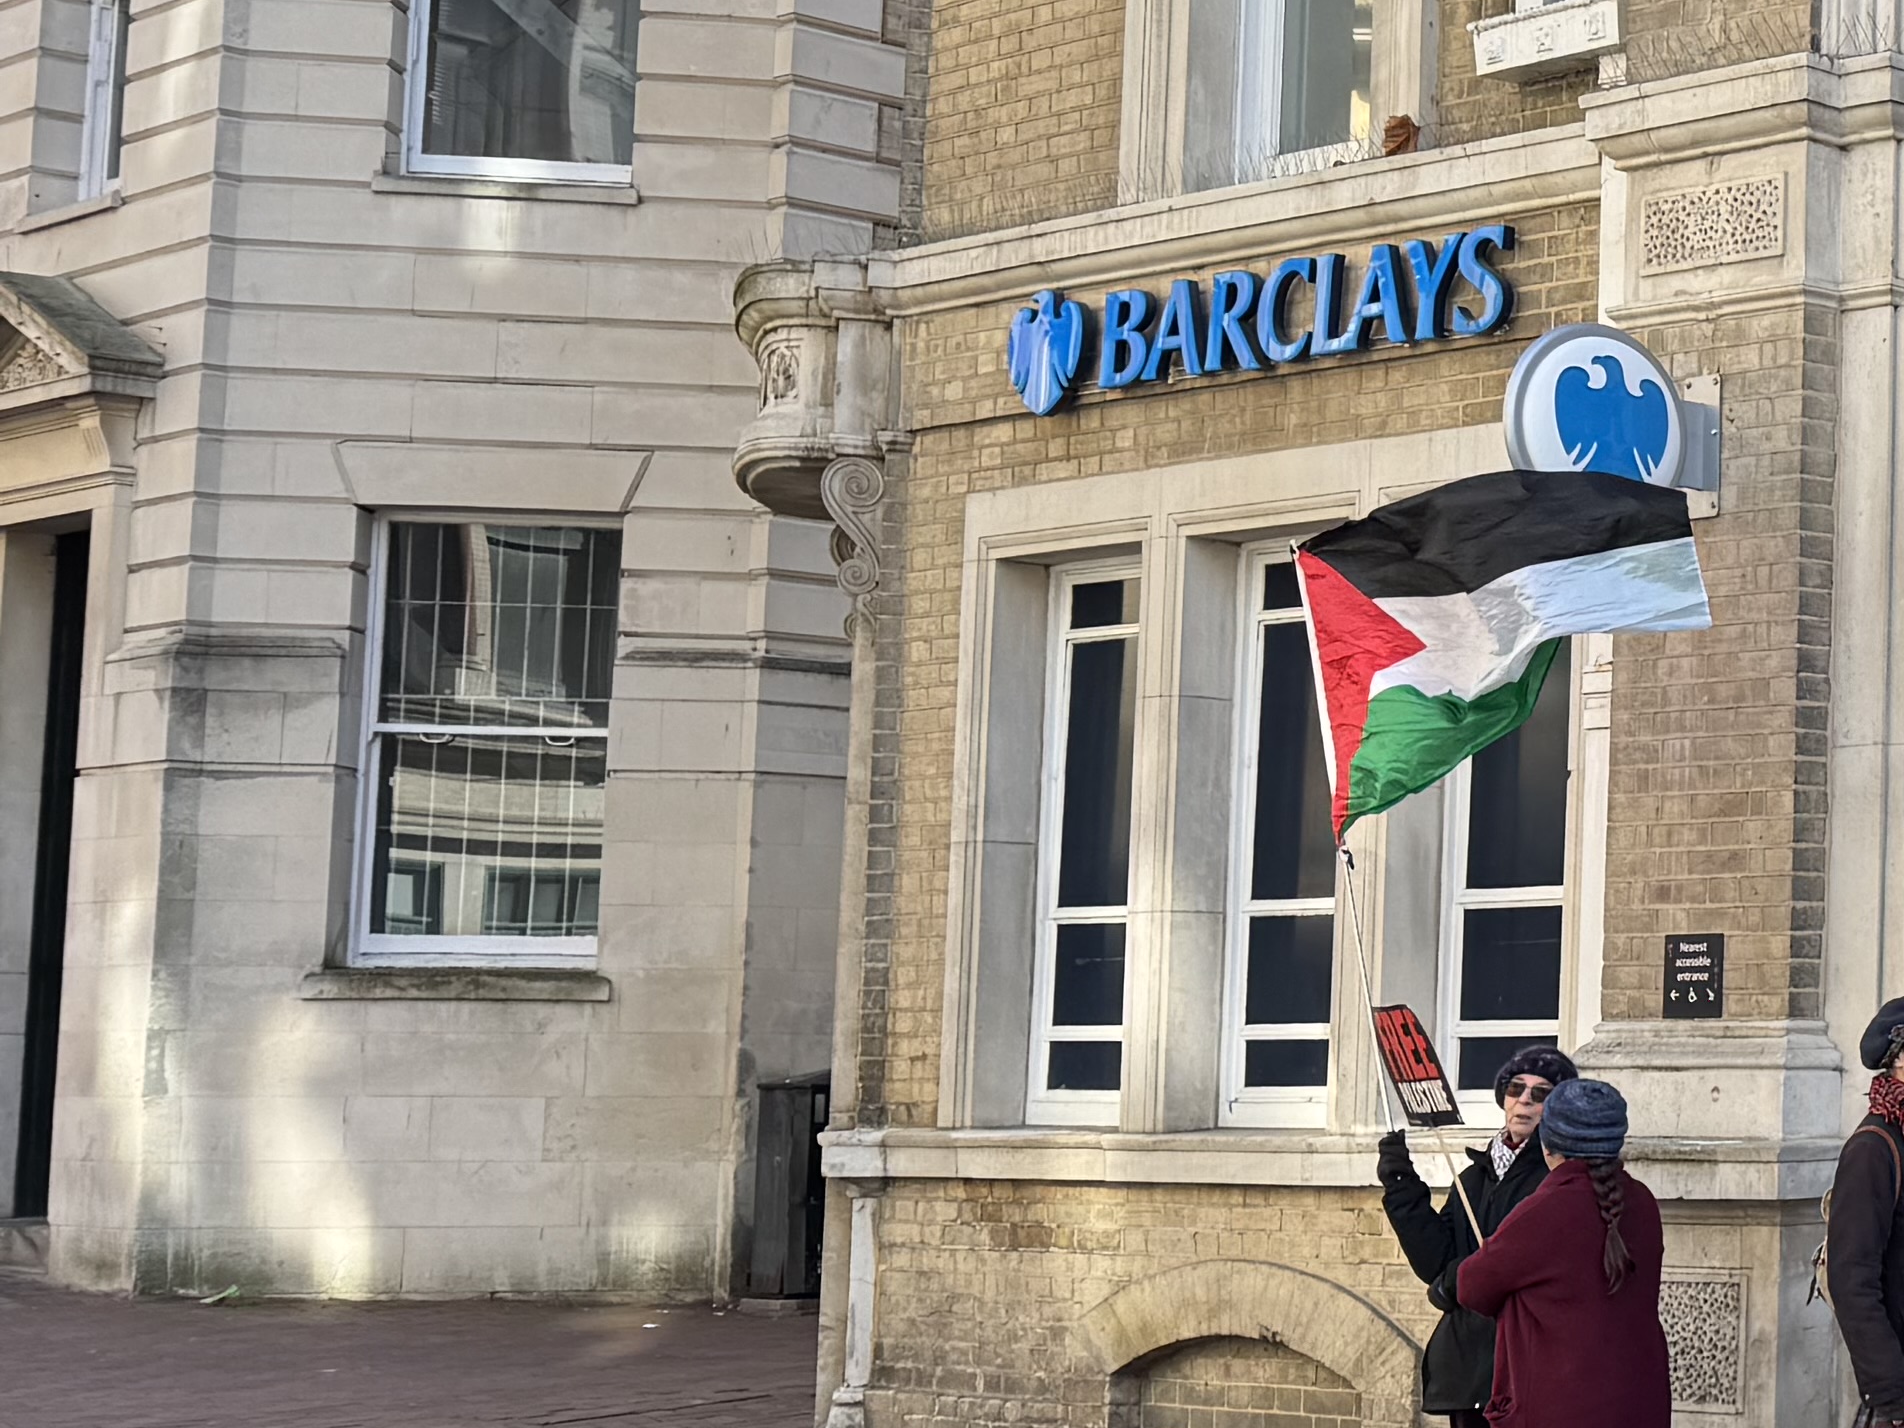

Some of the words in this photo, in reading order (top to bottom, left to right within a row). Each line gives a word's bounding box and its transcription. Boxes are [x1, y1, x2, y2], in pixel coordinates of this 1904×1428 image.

[1098, 223, 1516, 389] BARCLAYS
[1679, 942, 1707, 953] Nearest
[1675, 955, 1711, 967] accessible
[1677, 972, 1709, 982] entrance
[1374, 1009, 1441, 1082] FREE
